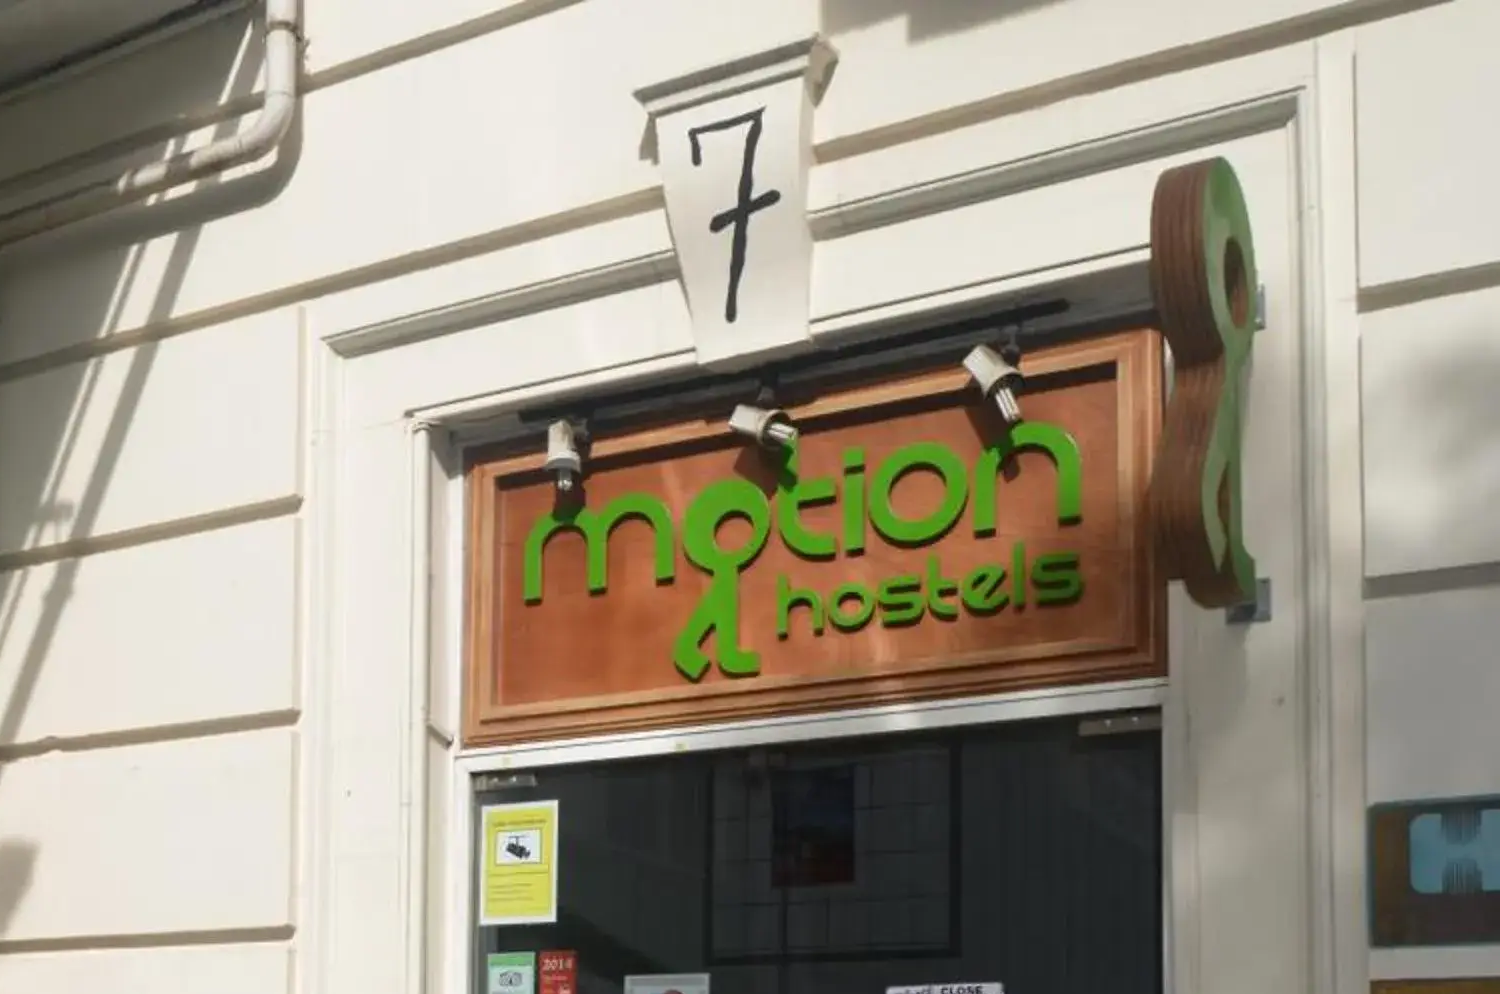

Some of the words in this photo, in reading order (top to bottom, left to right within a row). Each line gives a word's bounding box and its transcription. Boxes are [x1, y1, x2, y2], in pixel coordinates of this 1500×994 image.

[688, 105, 781, 323] 7
[523, 421, 1083, 679] motion
[776, 541, 1086, 640] hostels
